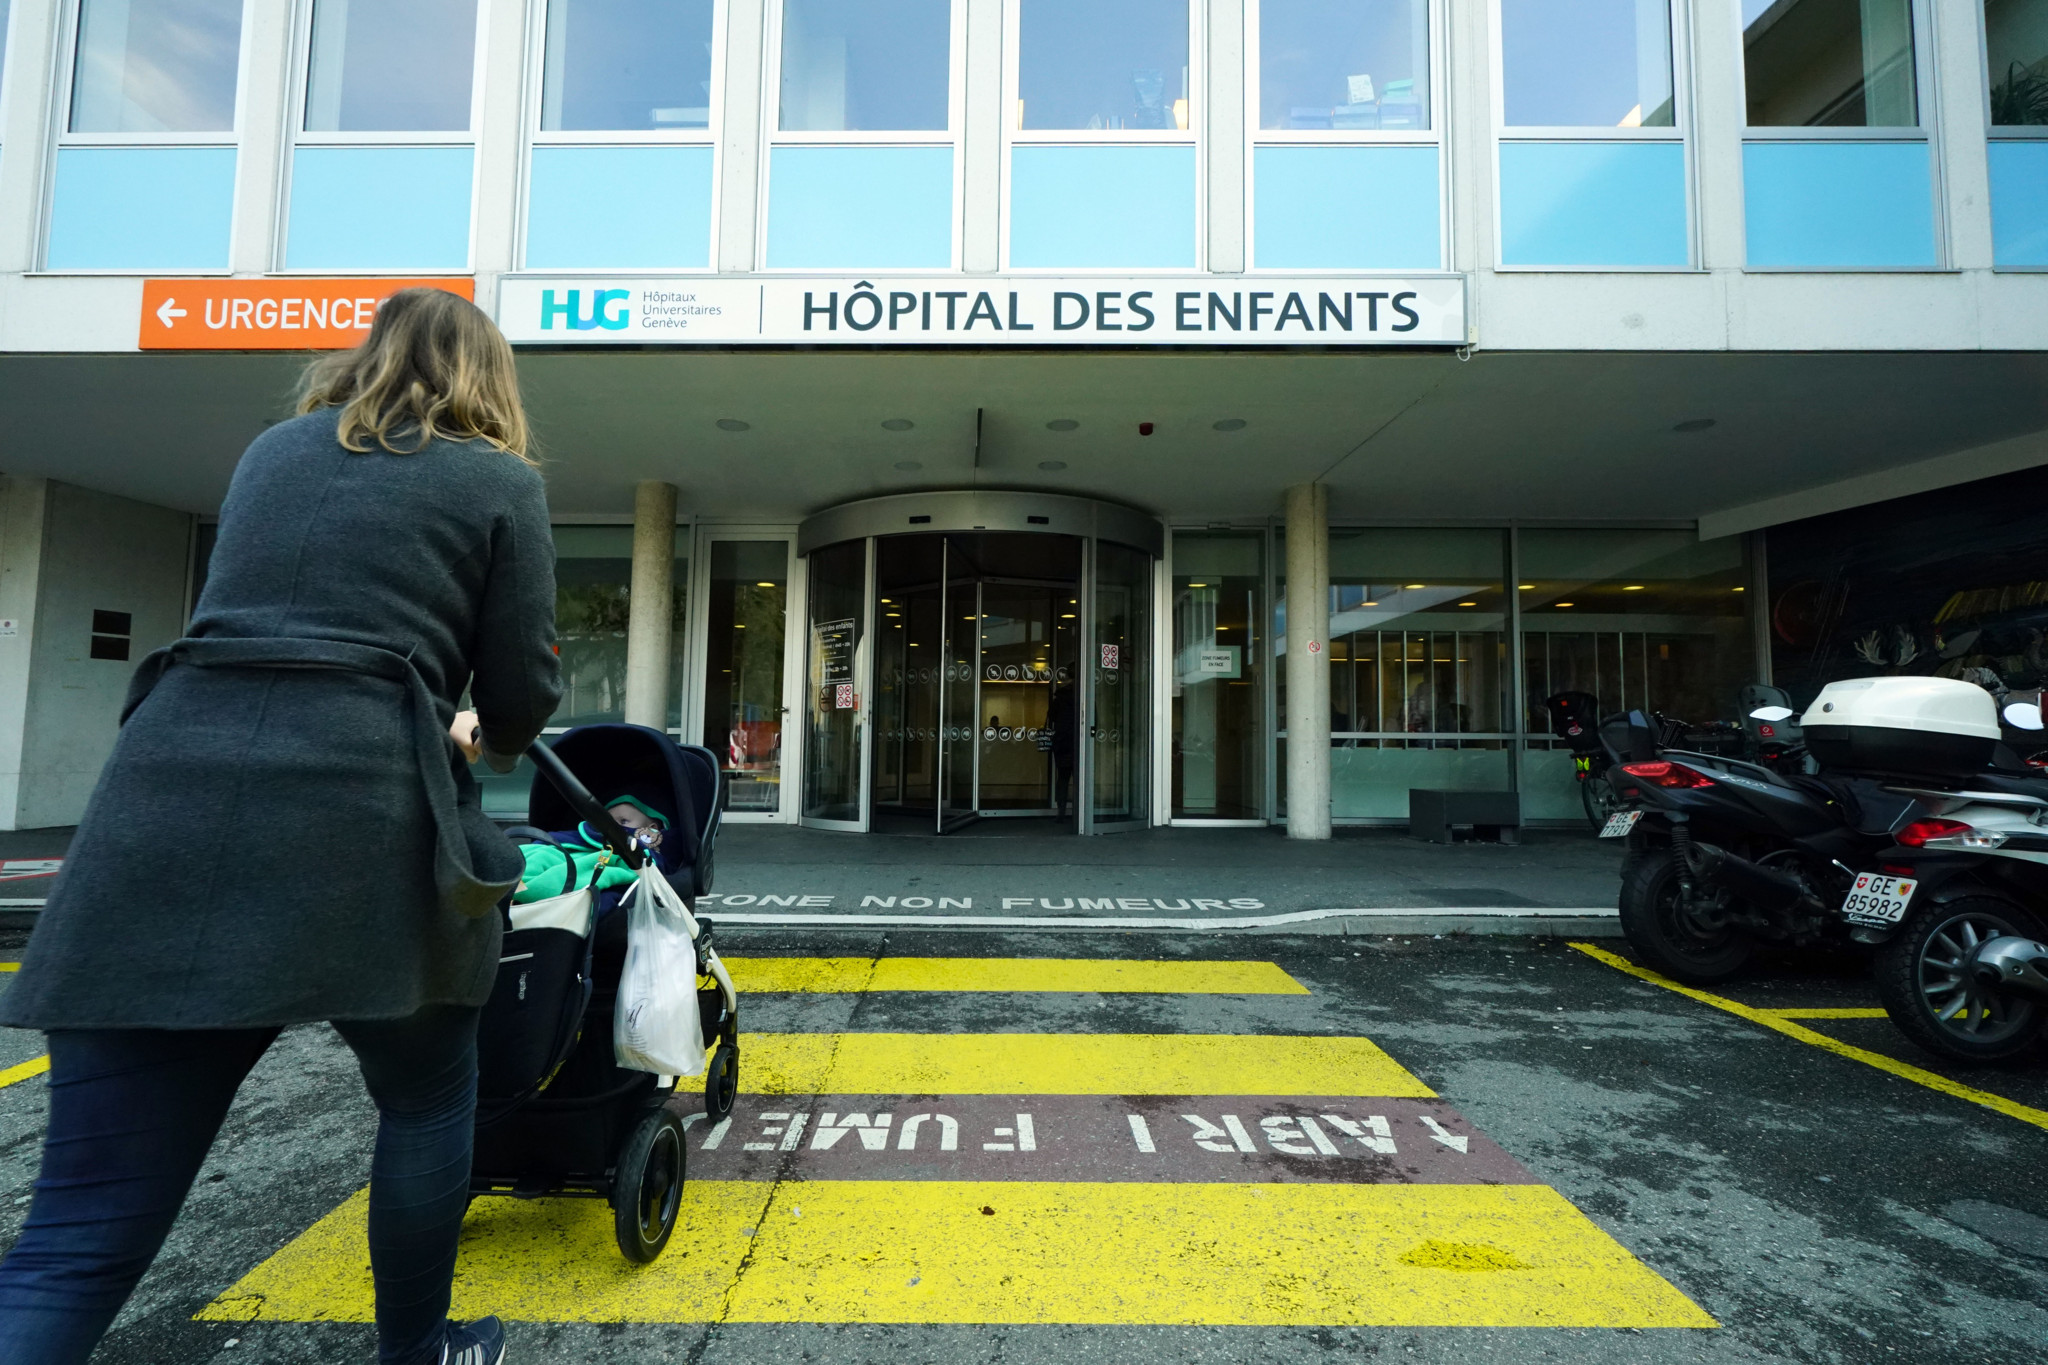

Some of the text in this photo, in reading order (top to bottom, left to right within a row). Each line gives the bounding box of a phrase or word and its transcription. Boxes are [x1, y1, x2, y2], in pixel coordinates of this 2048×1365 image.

[643, 290, 697, 304] Hôpitaux
[803, 280, 1420, 331] HÔPITAL DES ENFANTS
[205, 298, 391, 330] URGENCE
[540, 288, 631, 331] HUG
[642, 303, 722, 316] Universitaires
[641, 316, 688, 328] Genève
[1616, 812, 1631, 823] GE
[1870, 877, 1897, 896] GE
[860, 895, 973, 910] NON
[1003, 897, 1266, 911] FUMEURS
[1846, 894, 1903, 919] 85982
[1128, 1114, 1398, 1155] ABRI
